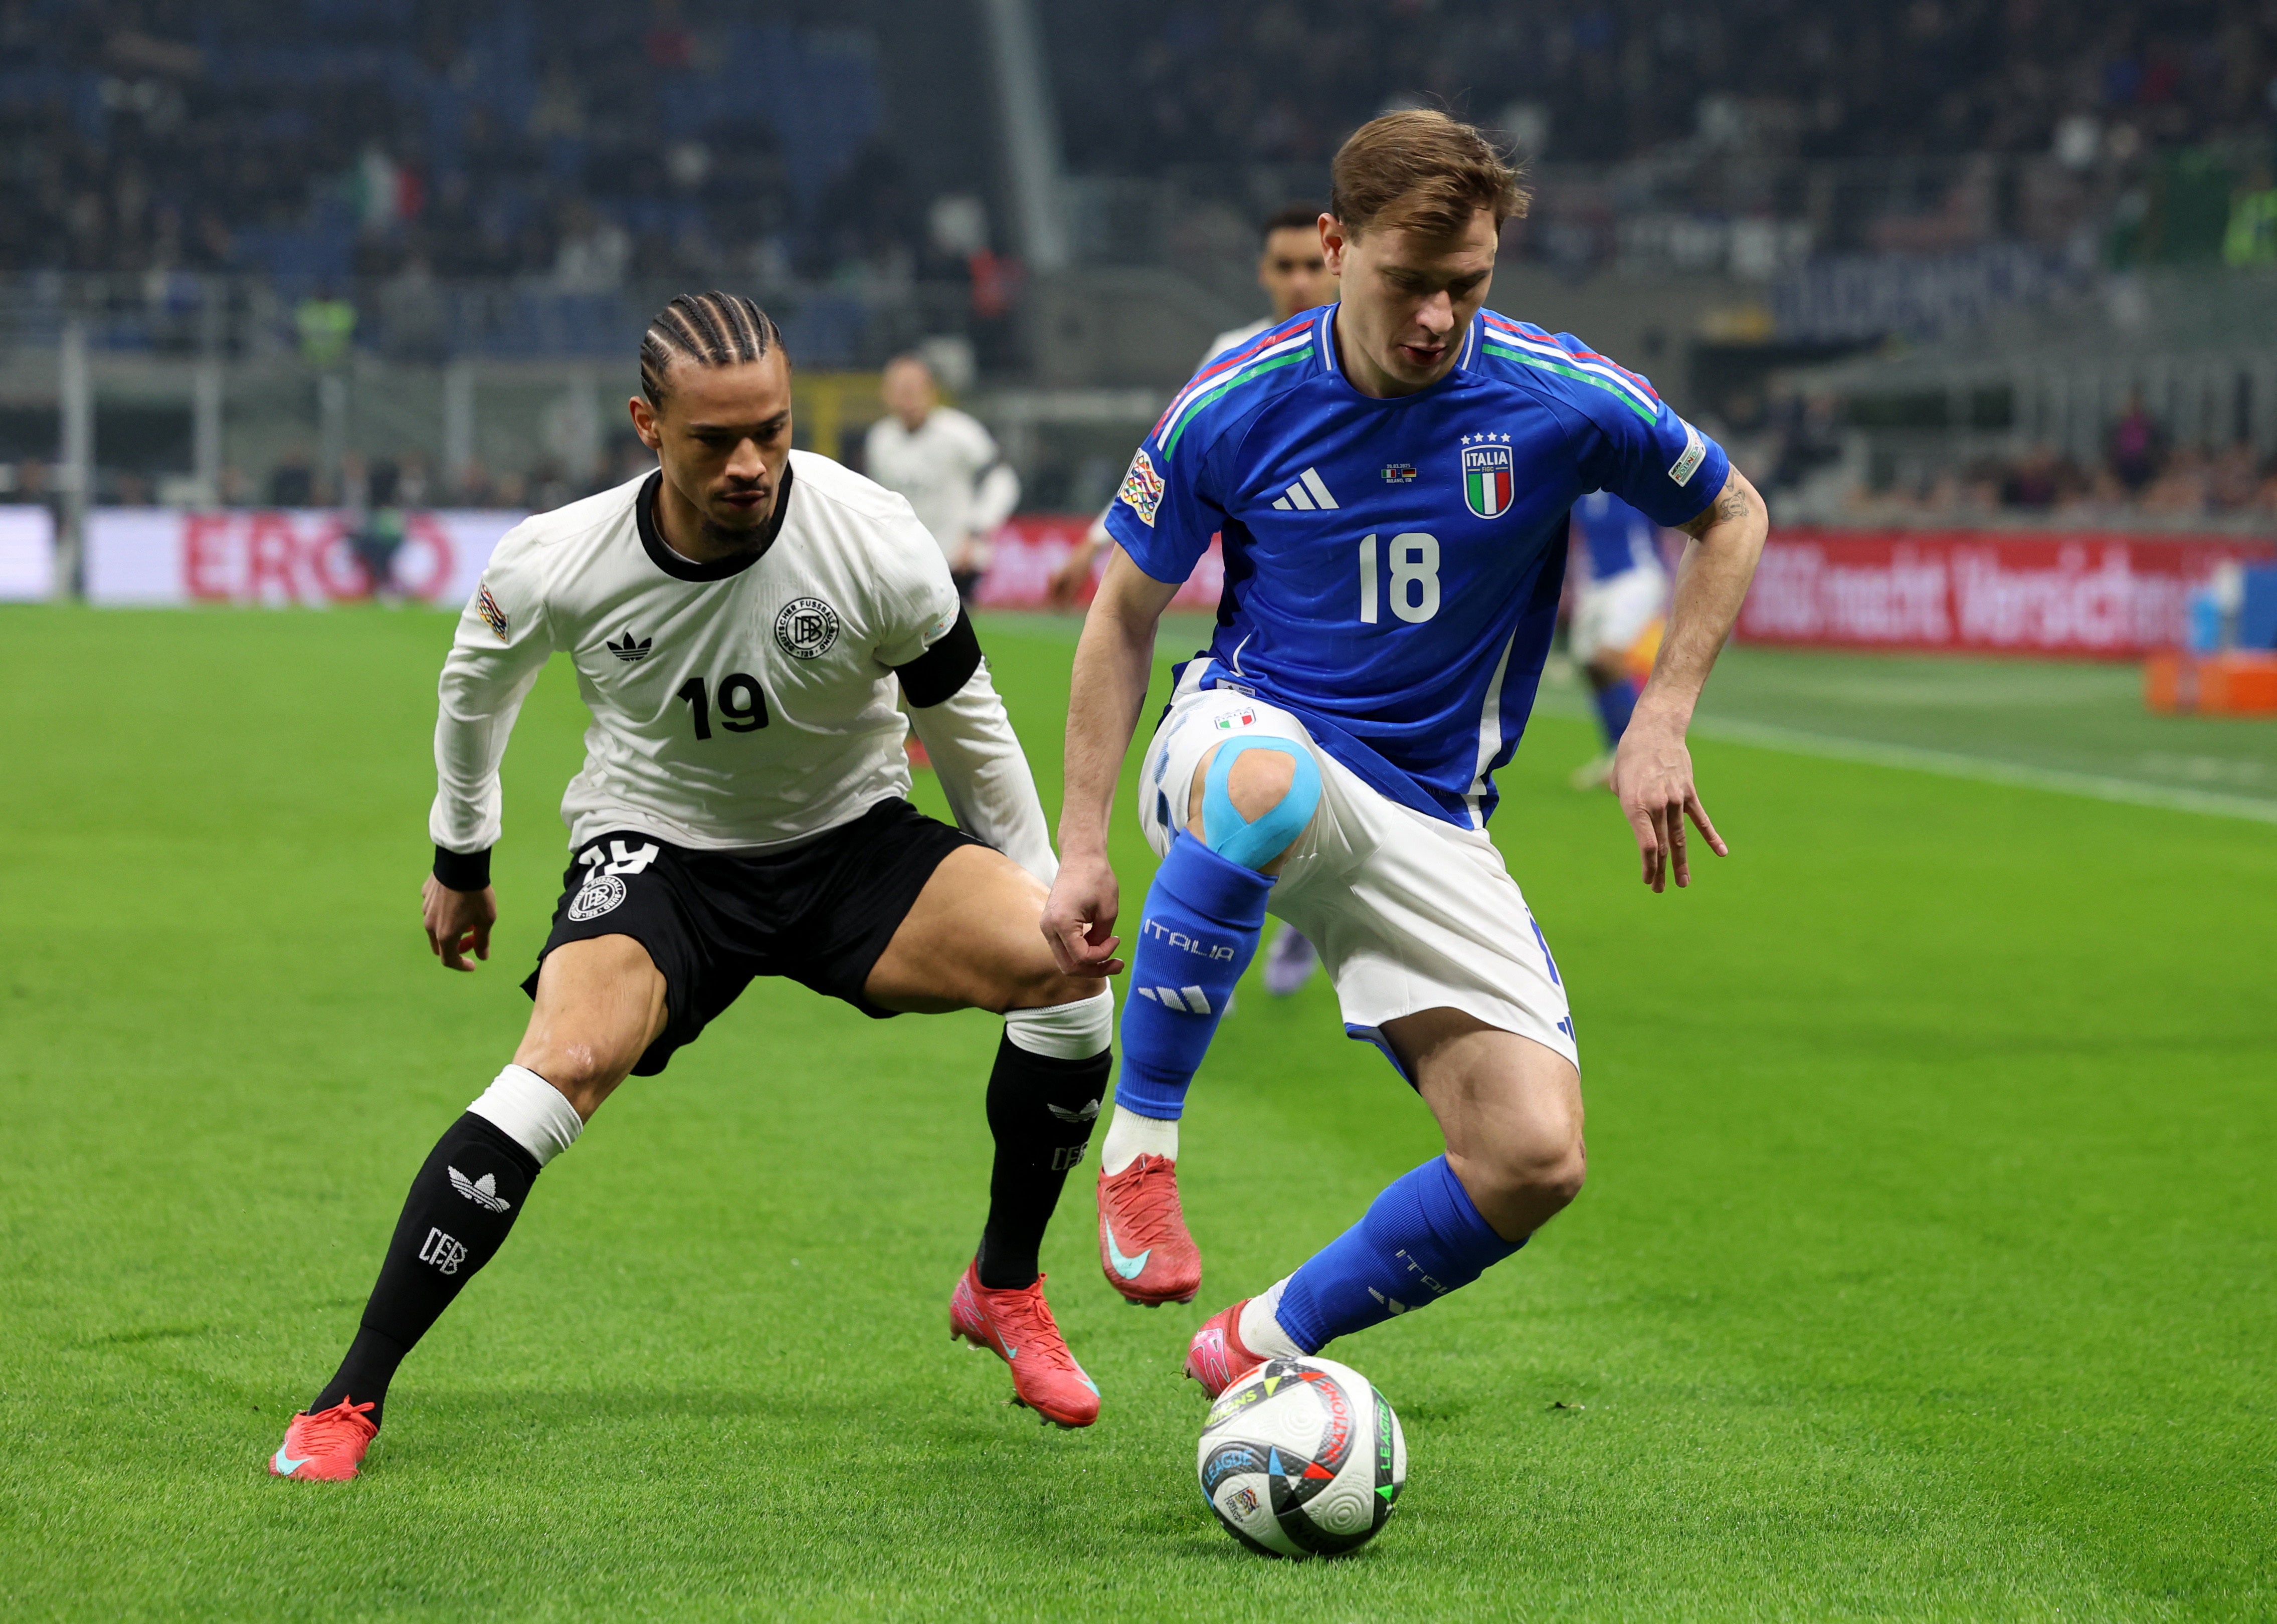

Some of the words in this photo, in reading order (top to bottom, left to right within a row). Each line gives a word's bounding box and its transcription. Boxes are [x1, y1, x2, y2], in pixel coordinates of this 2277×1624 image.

[1466, 452, 1508, 467] ITALIA
[1671, 462, 1681, 475] UEFA
[1675, 431, 1699, 480] FOUNDAT
[1359, 533, 1440, 624] 18
[778, 604, 797, 652] DEUTSCHER
[677, 673, 769, 740] 19
[1144, 918, 1235, 962] ITALIA
[1319, 1382, 1349, 1464] NATIONS
[1378, 1399, 1391, 1469] LEAGUE
[1204, 1450, 1253, 1486] LEAGUE
